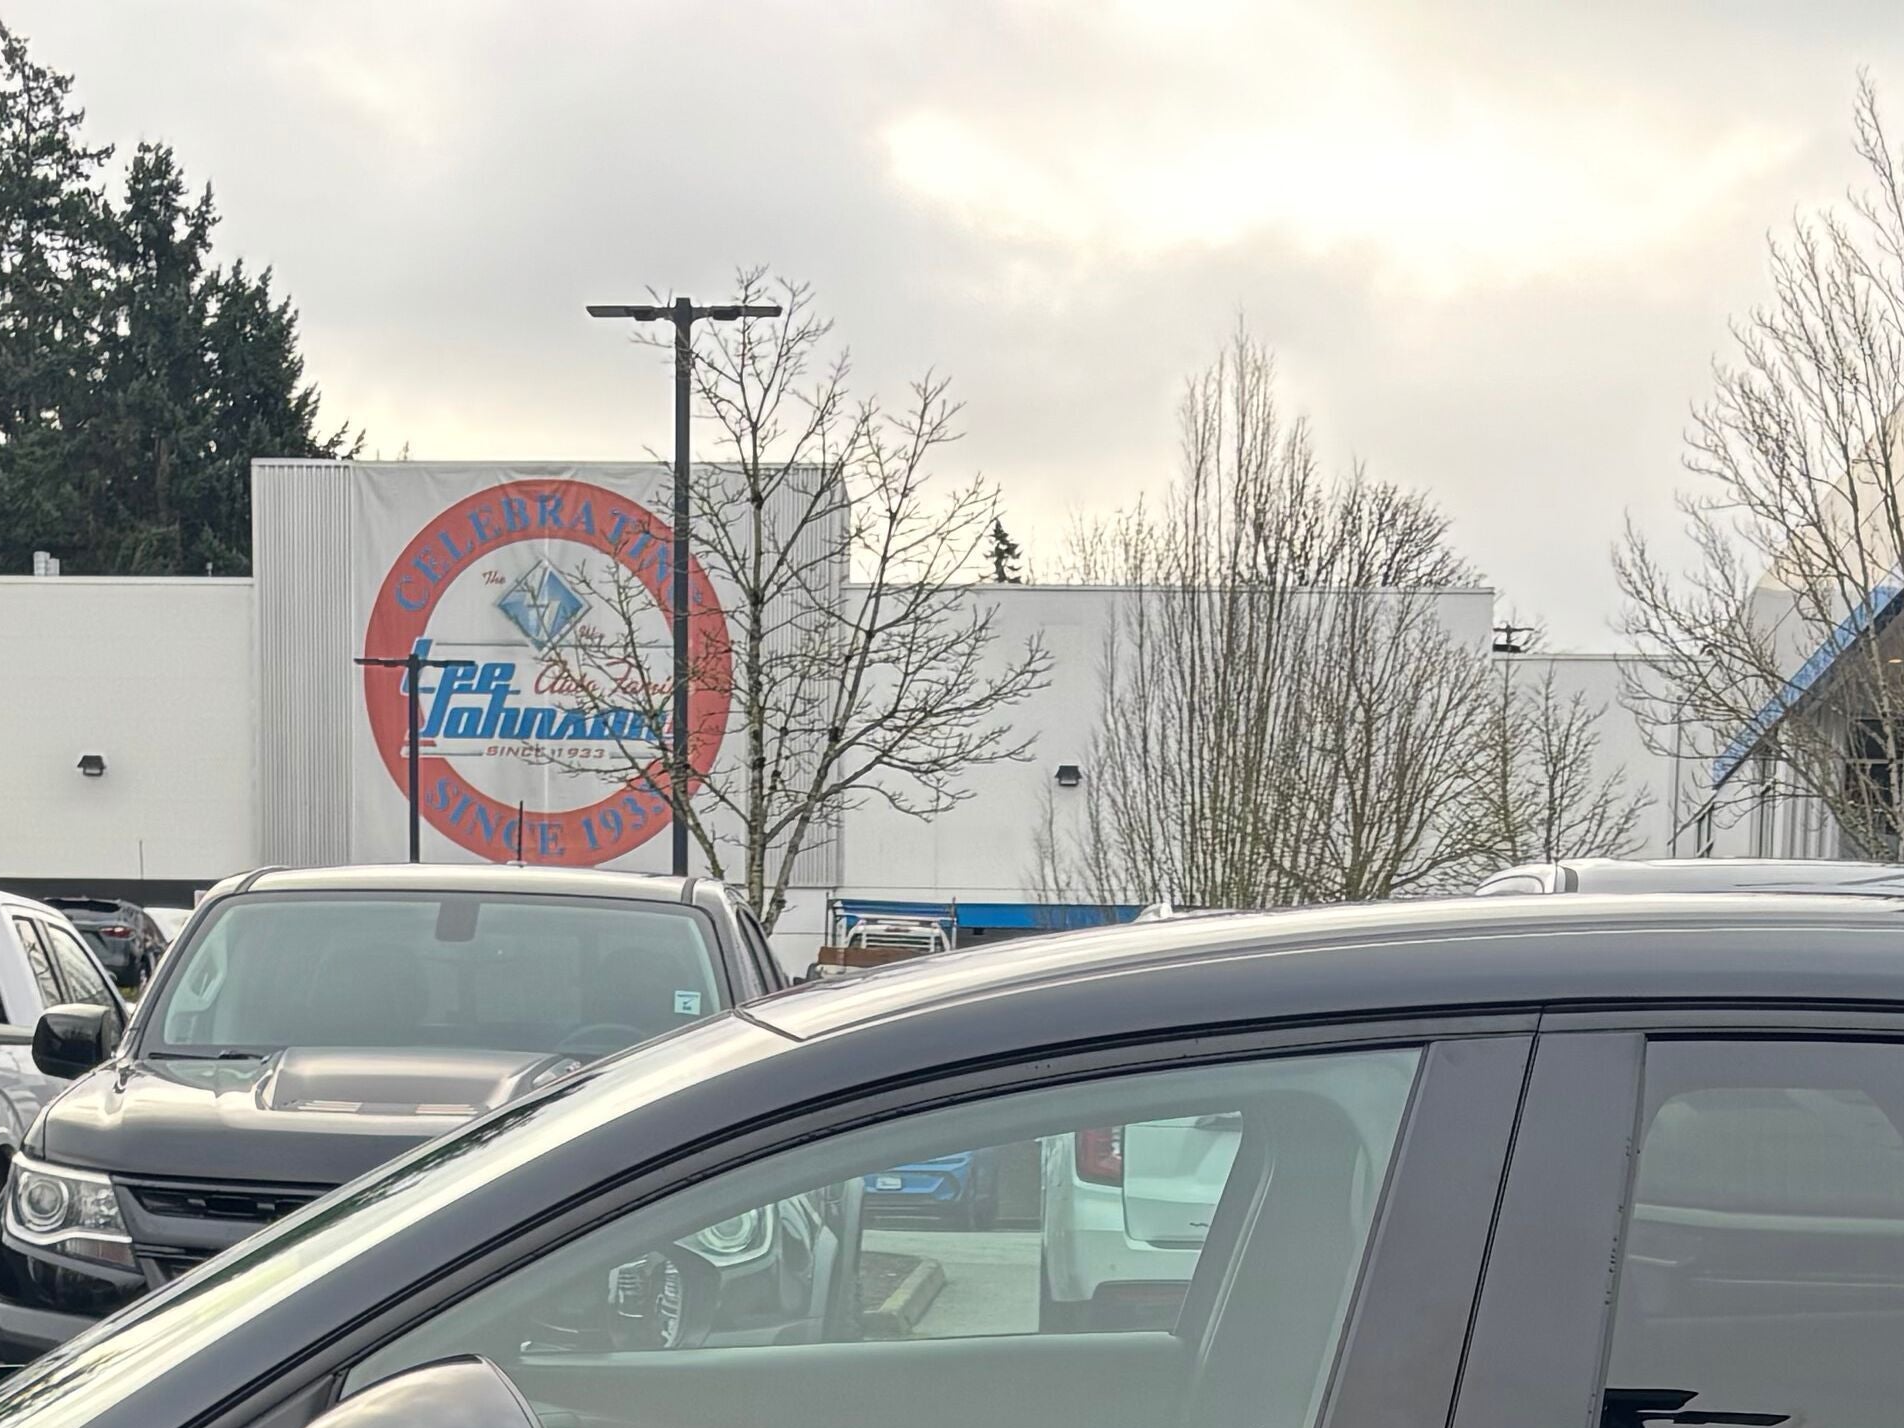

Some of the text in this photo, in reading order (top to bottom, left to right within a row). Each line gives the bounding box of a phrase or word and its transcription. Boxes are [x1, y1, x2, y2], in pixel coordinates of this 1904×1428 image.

[394, 494, 702, 612] CELEBRATIN
[482, 570, 506, 585] The
[604, 658, 676, 699] Fami
[416, 684, 673, 741] Johnson
[485, 745, 606, 760] SINCE 1933
[425, 777, 565, 856] SINCE
